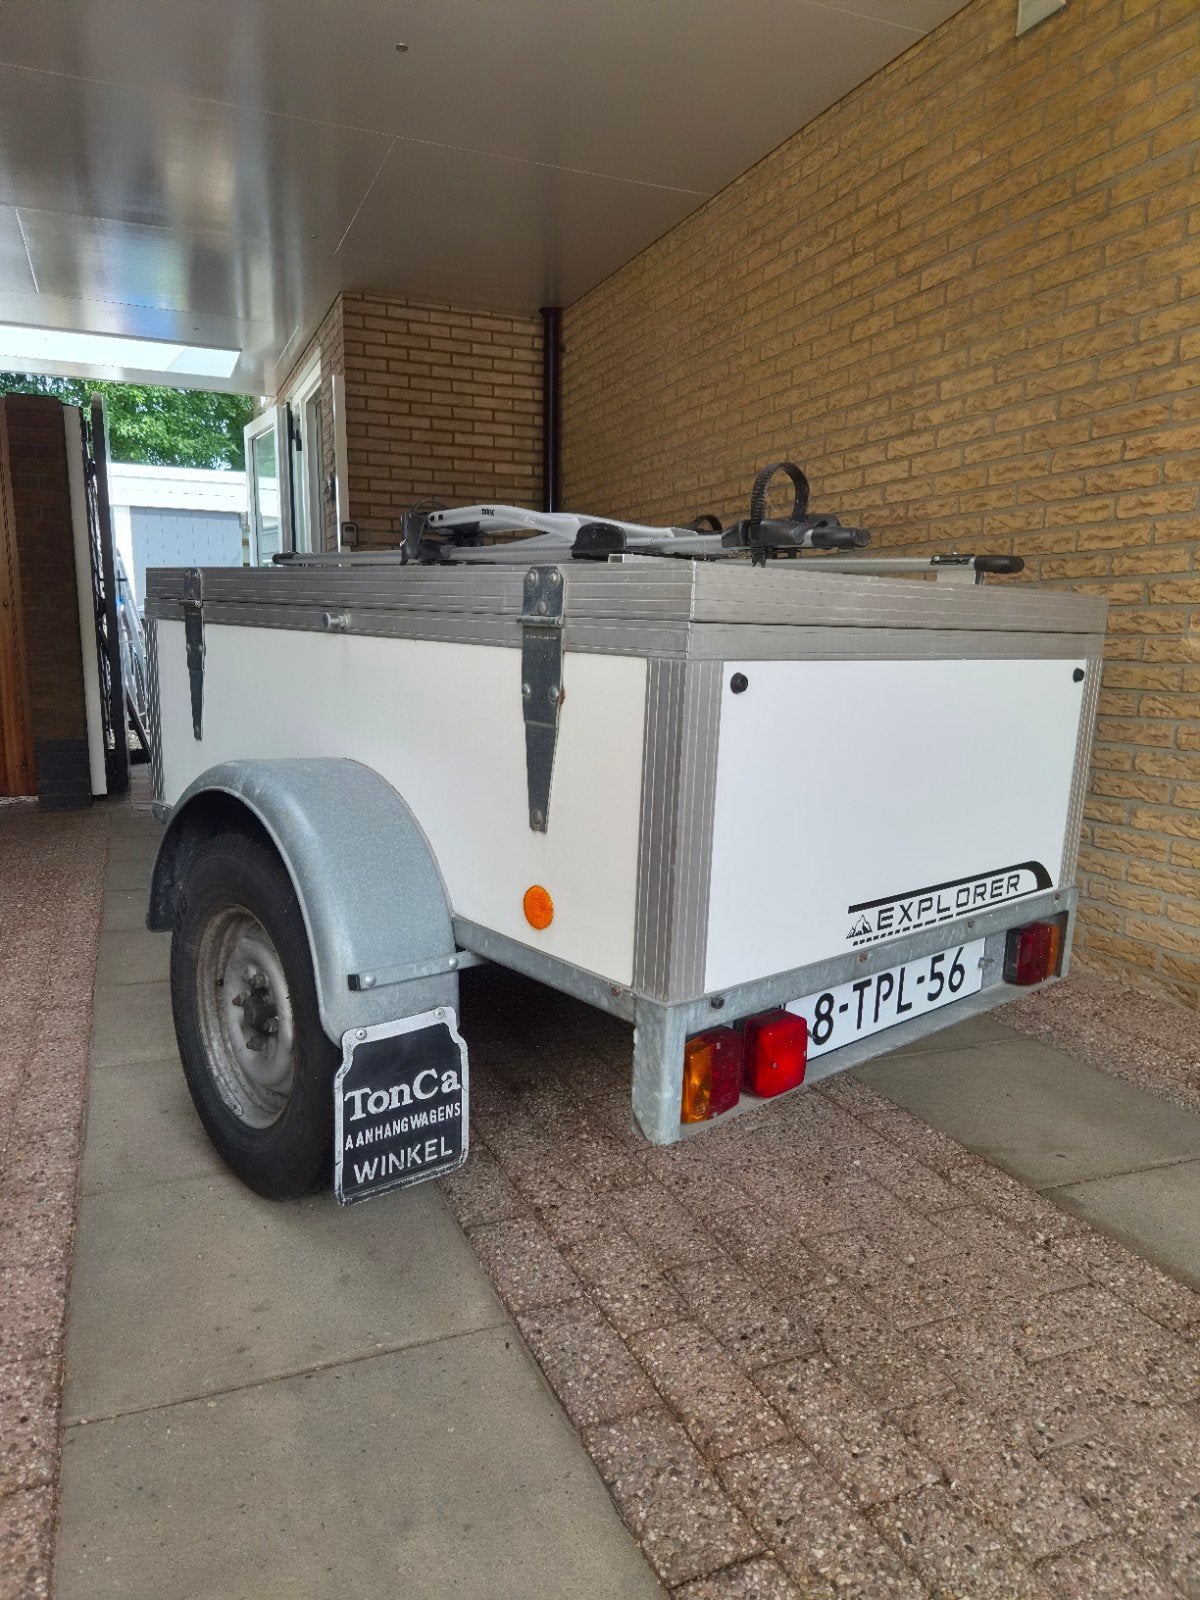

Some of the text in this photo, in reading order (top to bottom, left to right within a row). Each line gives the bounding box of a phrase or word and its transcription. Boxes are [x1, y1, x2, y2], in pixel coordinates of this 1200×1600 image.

[876, 874, 1021, 930] EXPLORER
[812, 946, 965, 1046] 8-TPL-56
[344, 1068, 461, 1121] TonCa
[345, 1102, 461, 1151] AANHANGWAGENS
[353, 1136, 453, 1184] WINKEL
